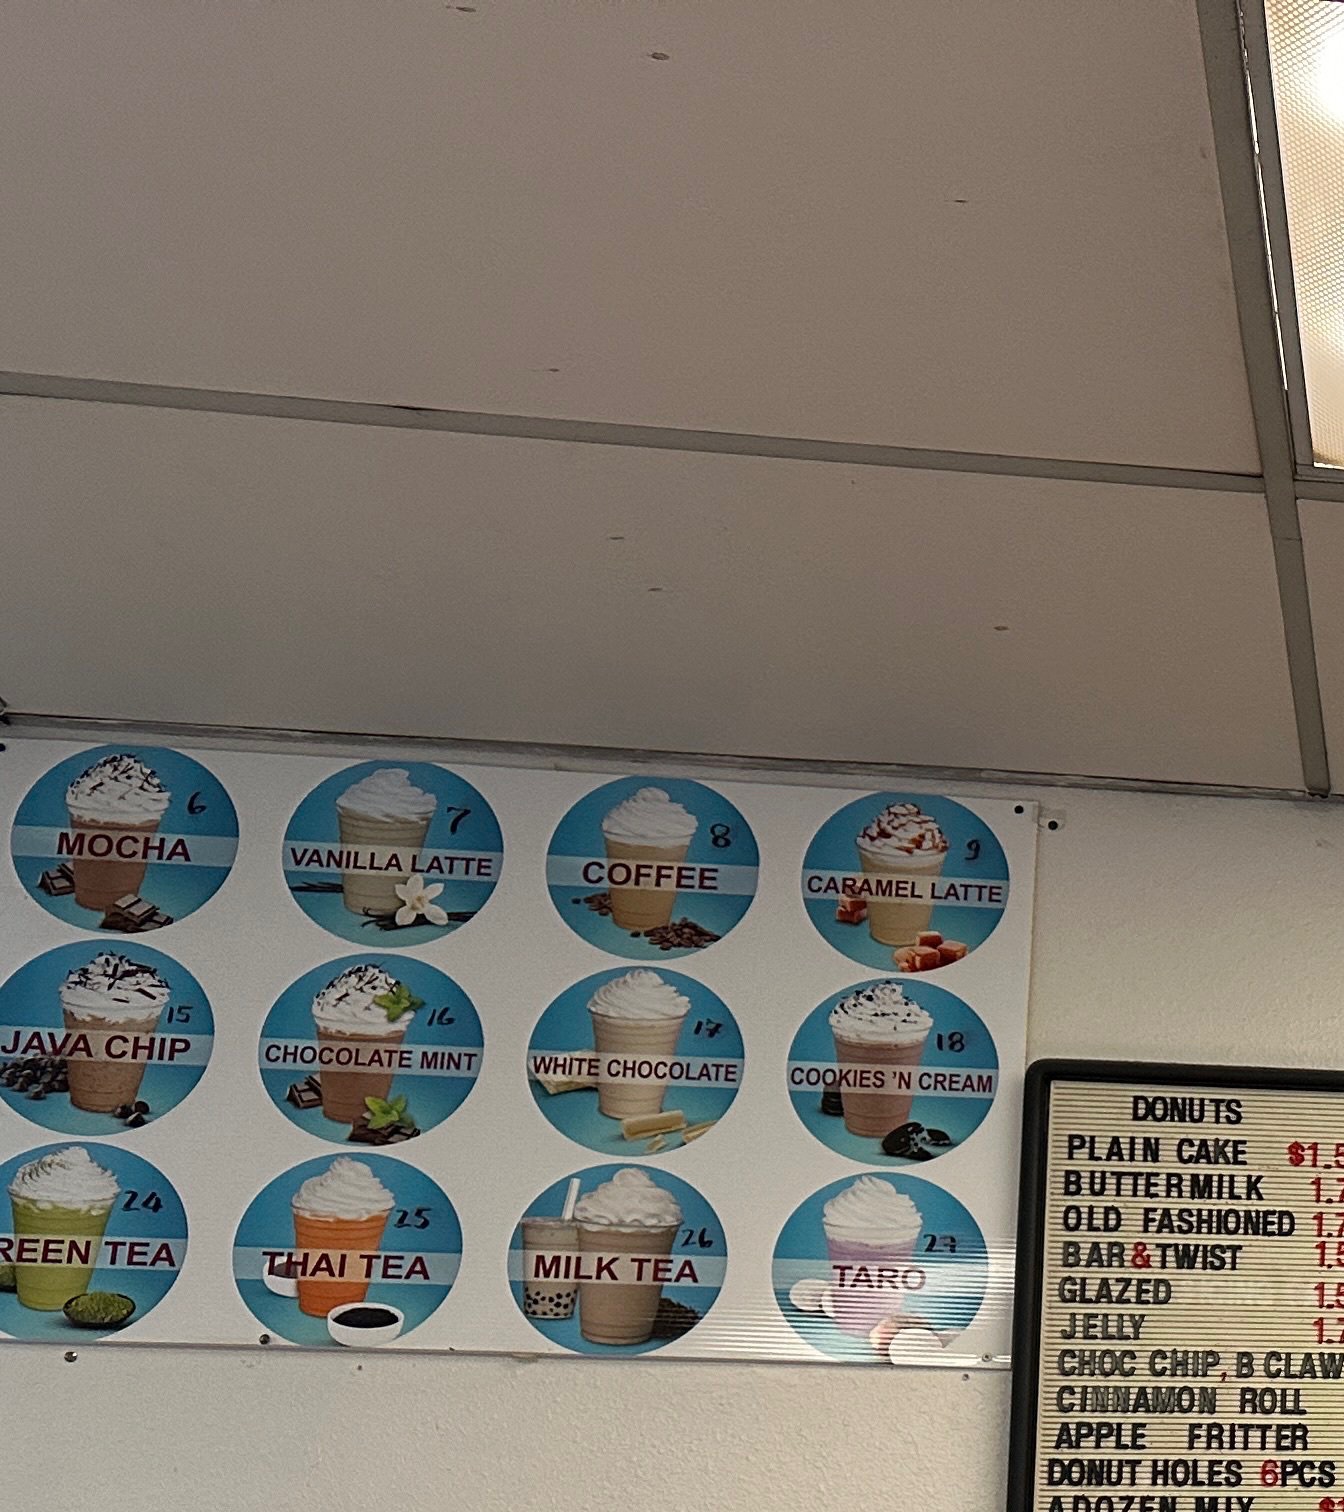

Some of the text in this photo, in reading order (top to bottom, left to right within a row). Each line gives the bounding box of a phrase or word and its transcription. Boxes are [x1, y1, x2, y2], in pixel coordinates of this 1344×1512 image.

[187, 792, 206, 815] 6
[447, 806, 471, 834] 7
[57, 831, 192, 862] MOCHA
[290, 847, 493, 877] VANILLA LATTE
[582, 861, 719, 890] COFFEE
[807, 875, 1003, 904] CARAMEL LATTE
[167, 1005, 193, 1024] 15
[1, 1030, 192, 1062] JAVA CHIP
[264, 1044, 477, 1072] CHOCOLATE MINT
[533, 1056, 738, 1082] WHITE CHOCOLATE
[790, 1067, 885, 1089] COOKIES
[918, 1073, 993, 1094] CREAM
[1132, 1095, 1243, 1125] DONUTS
[1067, 1134, 1160, 1162] PLAIN
[1177, 1139, 1247, 1165] CAKE
[1063, 1171, 1264, 1200] BUTTERMILK
[121, 1190, 164, 1213] 24
[1063, 1205, 1295, 1237] OLD FASHIONED
[0, 1238, 176, 1268] REEN TEA
[261, 1251, 431, 1281] THAI TEA
[533, 1254, 699, 1284] MILK TEA
[832, 1264, 927, 1290] TARO
[1059, 1276, 1171, 1304] GLAZED
[1060, 1312, 1145, 1340] JELLY
[1058, 1349, 1344, 1379] CHOC CLAW
[1056, 1386, 1307, 1414] CINNAMON ROLL
[1054, 1422, 1308, 1450] APPLE FRITTER
[1049, 1458, 1243, 1487] DONUT HOLES
